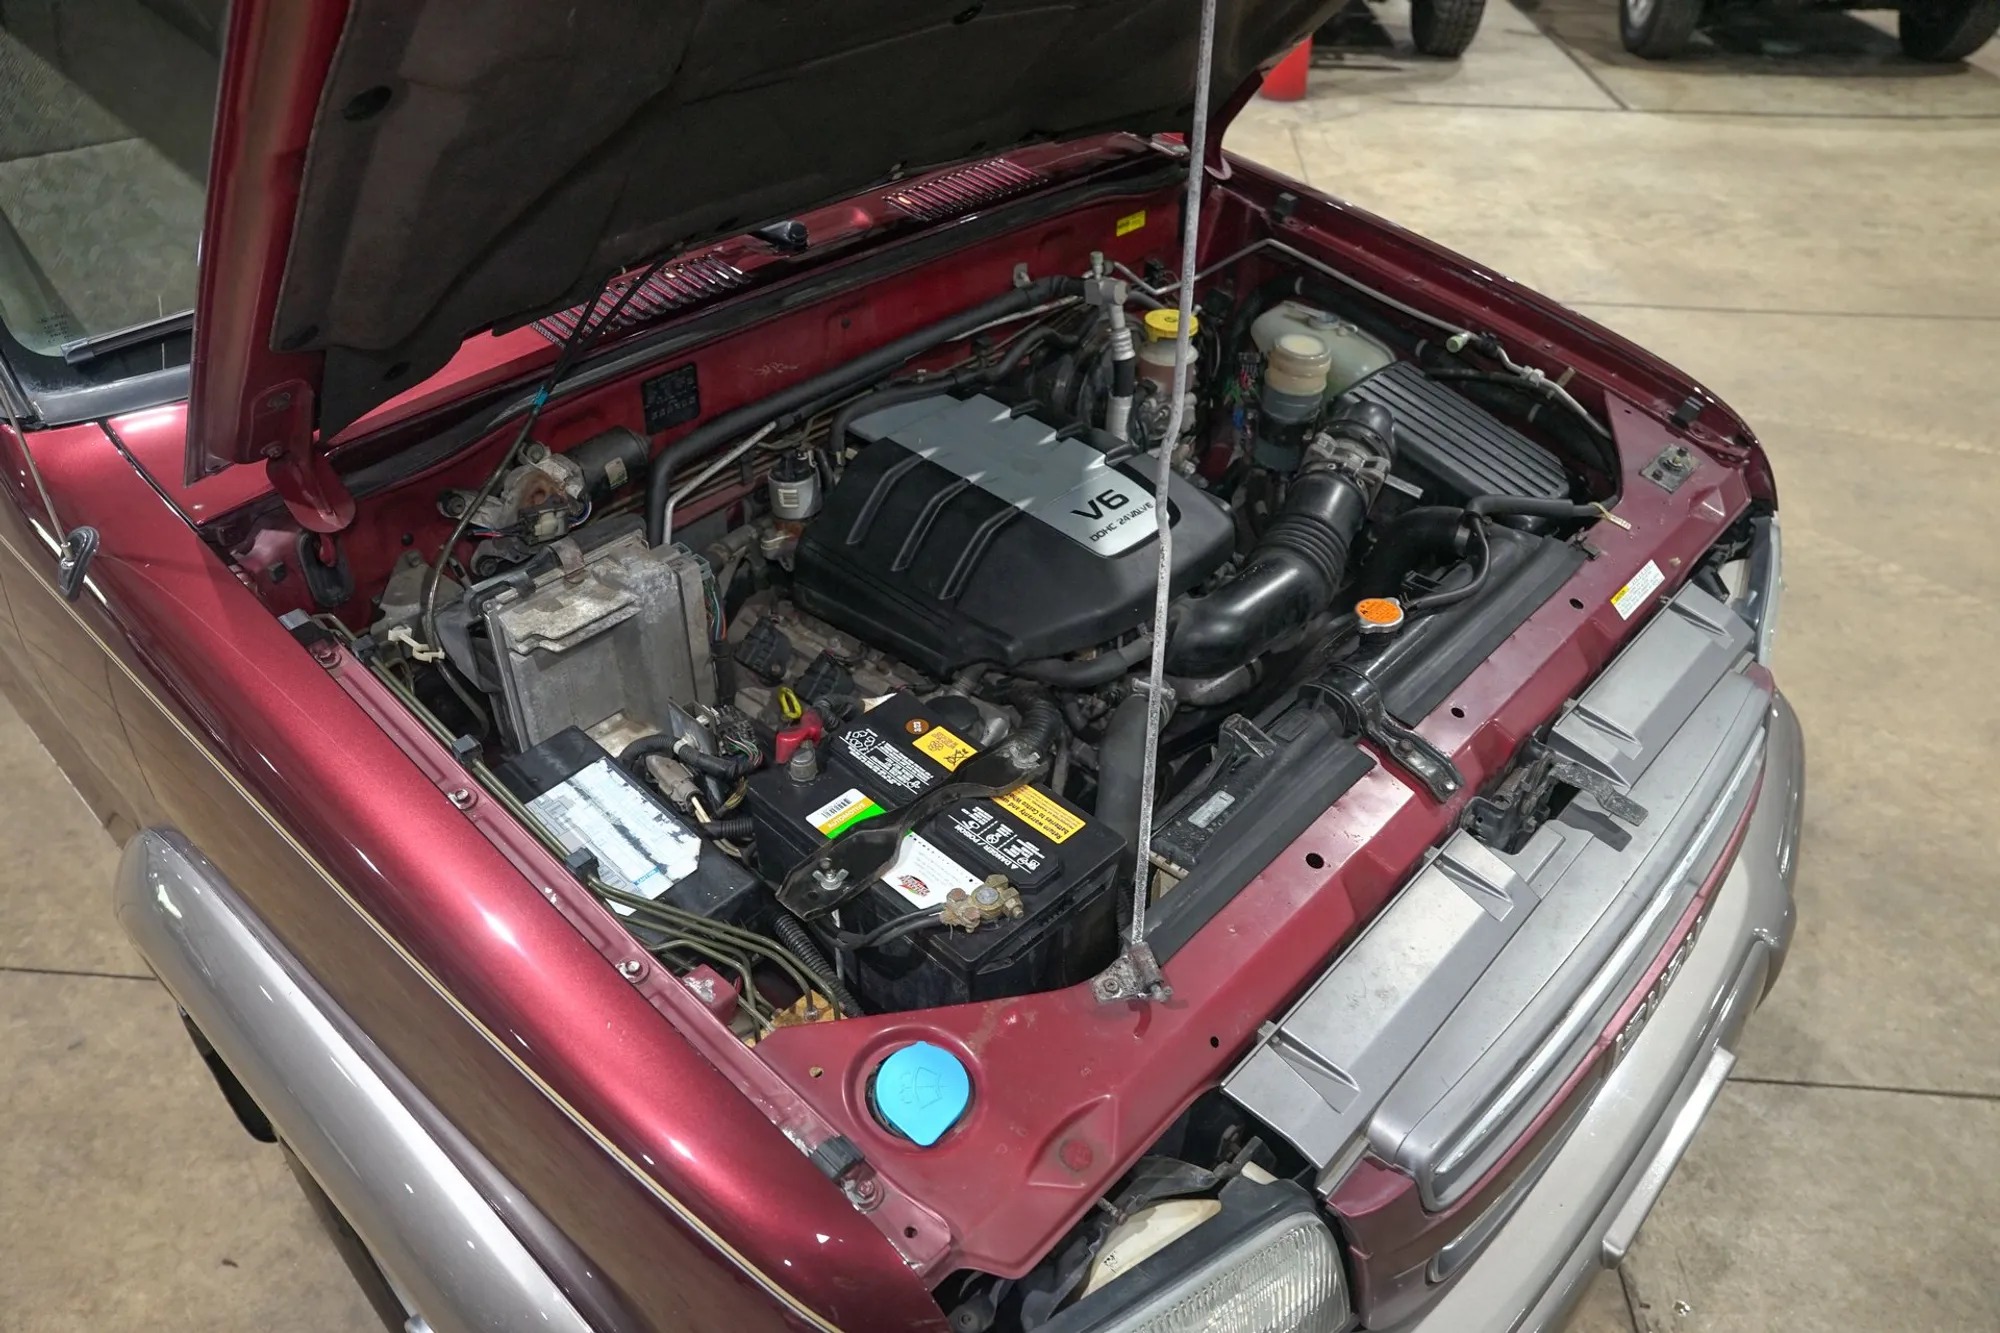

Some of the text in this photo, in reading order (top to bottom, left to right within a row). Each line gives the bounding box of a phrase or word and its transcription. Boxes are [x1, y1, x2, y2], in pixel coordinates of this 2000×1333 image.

[1070, 489, 1130, 520] V6
[1089, 523, 1118, 542] DOHC
[1007, 801, 1019, 810] and
[1020, 800, 1039, 815] Costco
[1018, 808, 1043, 826] warranty
[1044, 815, 1069, 835] batteries
[954, 824, 980, 843] POISON
[1042, 824, 1062, 840] Return
[983, 844, 1012, 866] DANGER
